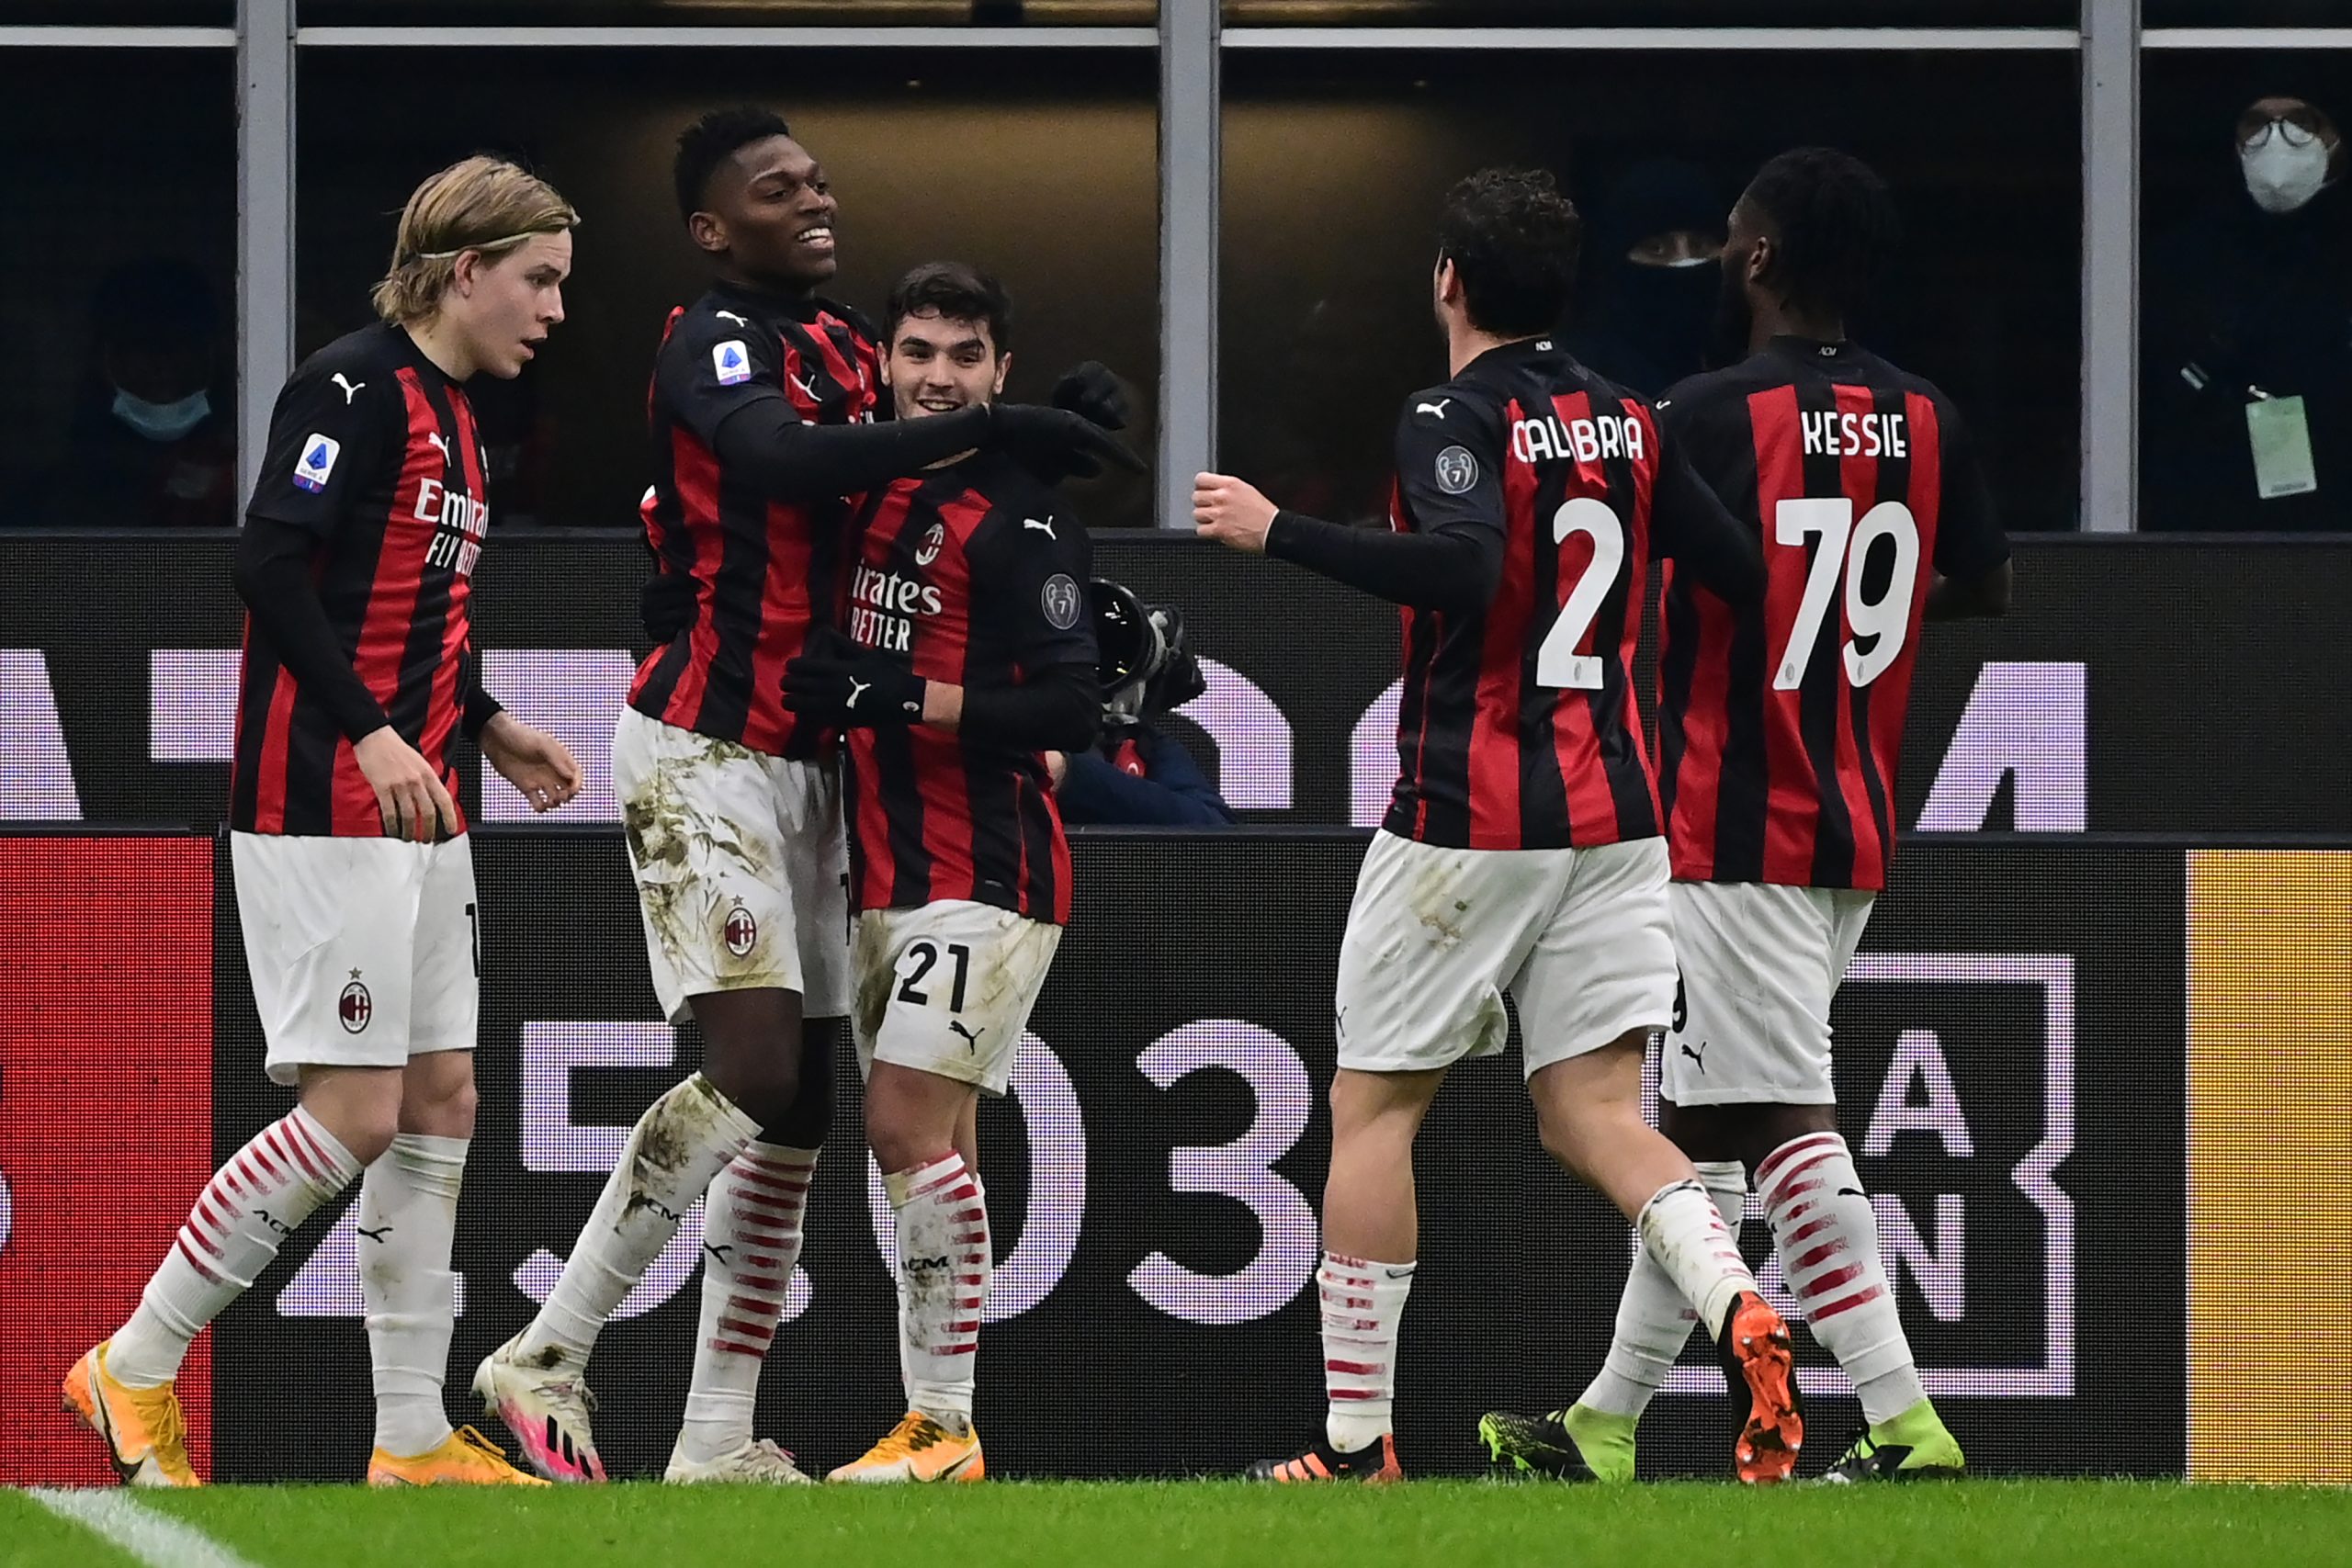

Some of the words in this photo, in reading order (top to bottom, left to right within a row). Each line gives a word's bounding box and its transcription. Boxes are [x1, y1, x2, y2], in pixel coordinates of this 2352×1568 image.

[1801, 411, 1906, 458] KESSIE
[1452, 469, 1462, 482] 7
[413, 477, 489, 540] Emira
[424, 532, 460, 569] FLY
[852, 557, 942, 615] irates
[1057, 600, 1067, 615] 7
[1536, 497, 1624, 690] 2
[1772, 498, 1920, 690] 79
[850, 606, 910, 651] BETTER
[897, 942, 969, 1013] 21
